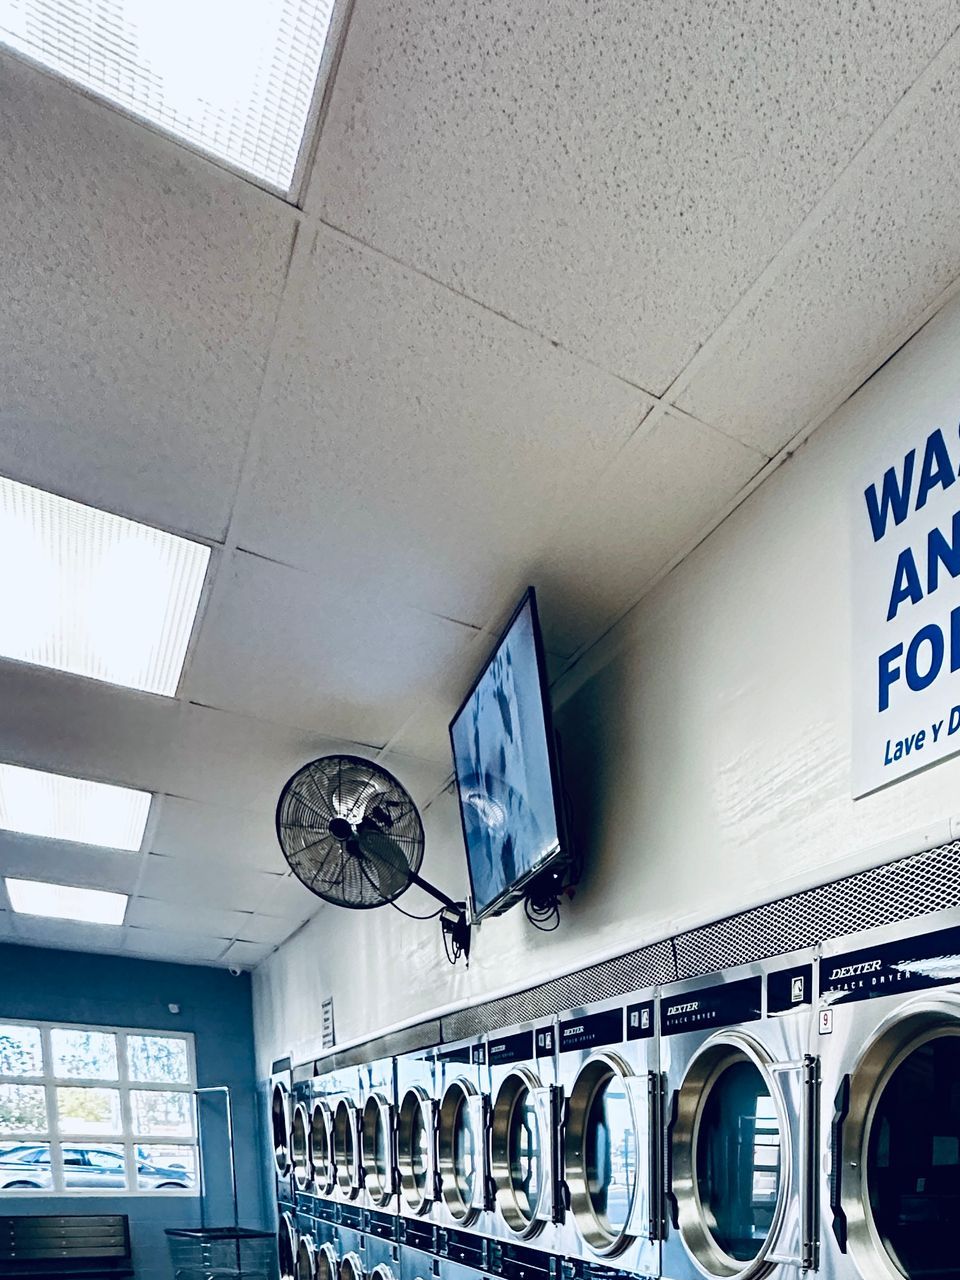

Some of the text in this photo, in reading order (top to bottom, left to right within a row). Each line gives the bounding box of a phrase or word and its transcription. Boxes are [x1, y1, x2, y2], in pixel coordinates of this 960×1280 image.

[884, 729, 926, 766] Lave
[931, 719, 944, 743] Y
[828, 959, 882, 981] DEXTER
[829, 970, 911, 993] STACK DRYER
[666, 1001, 699, 1016] DEXTER
[823, 1012, 829, 1026] 9
